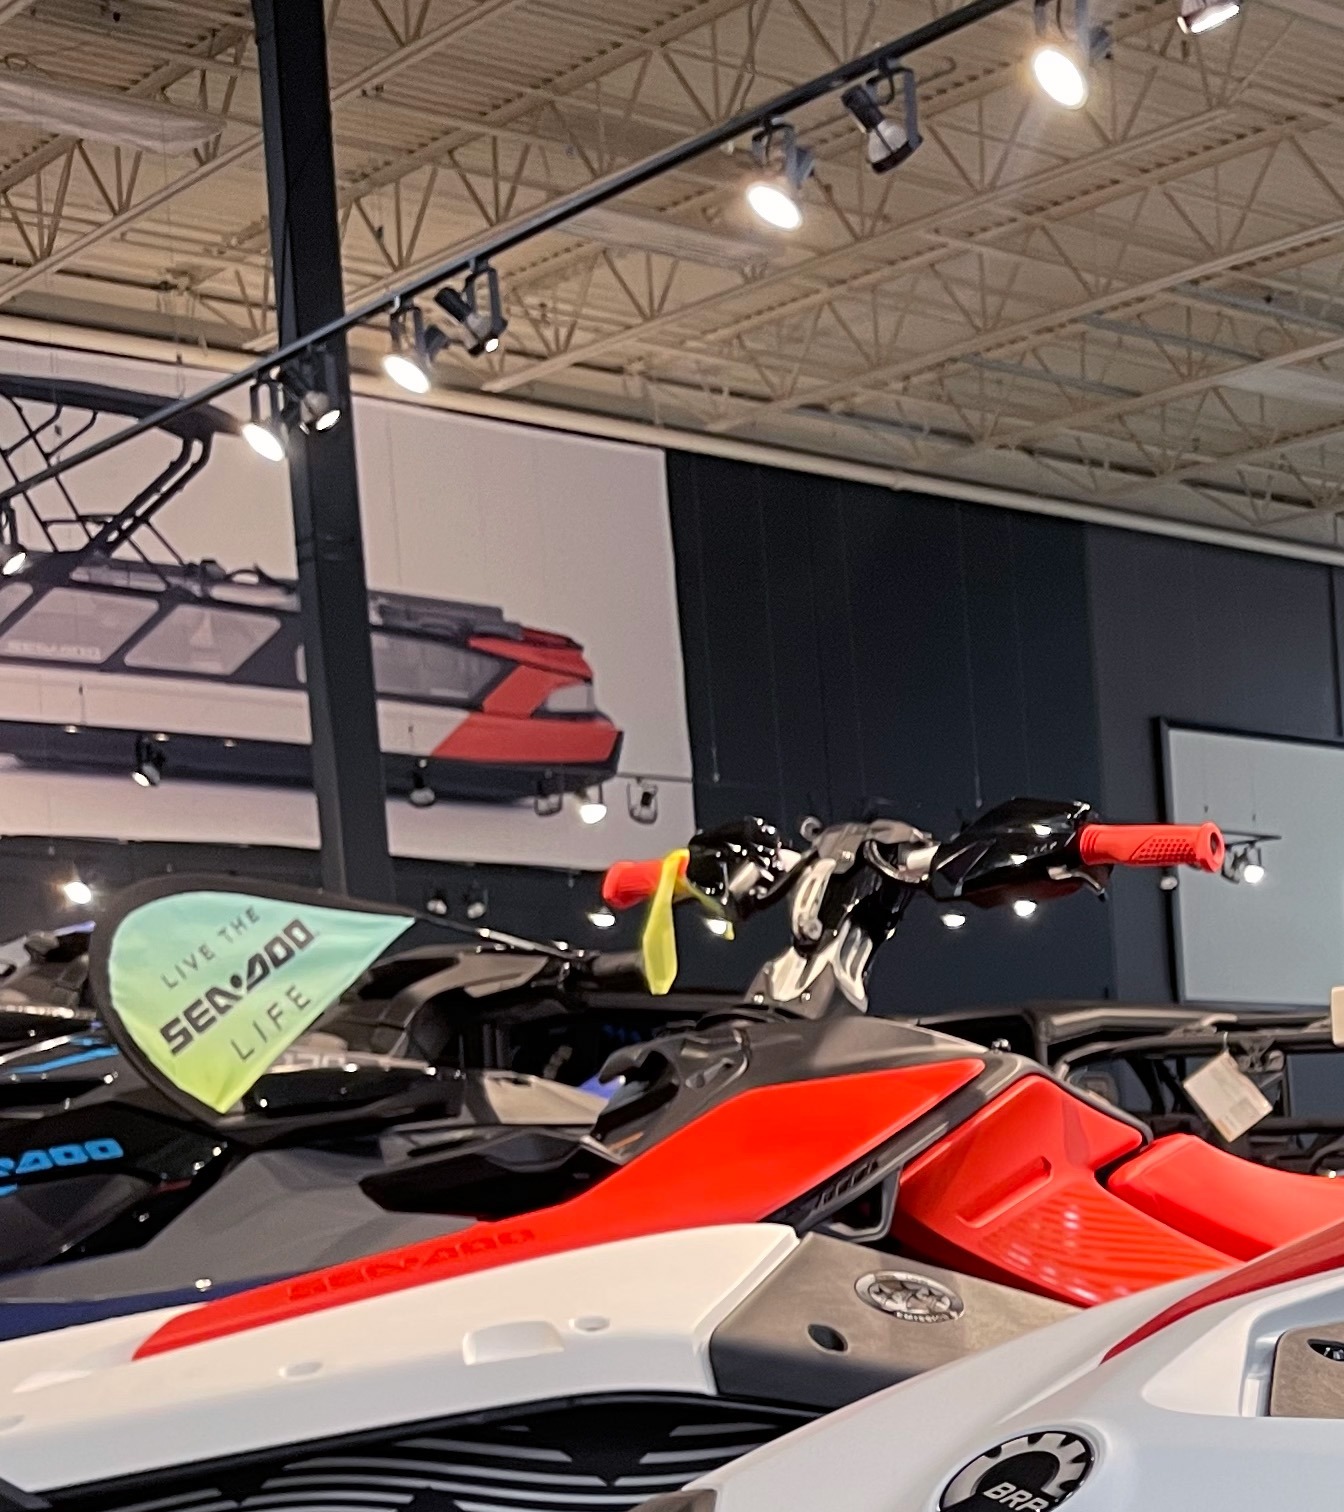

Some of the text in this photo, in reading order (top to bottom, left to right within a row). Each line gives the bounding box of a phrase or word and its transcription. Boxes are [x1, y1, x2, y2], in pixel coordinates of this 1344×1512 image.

[159, 905, 261, 990] LIVE THE
[230, 983, 312, 1062] LIFE
[982, 1481, 1050, 1512] BRP
